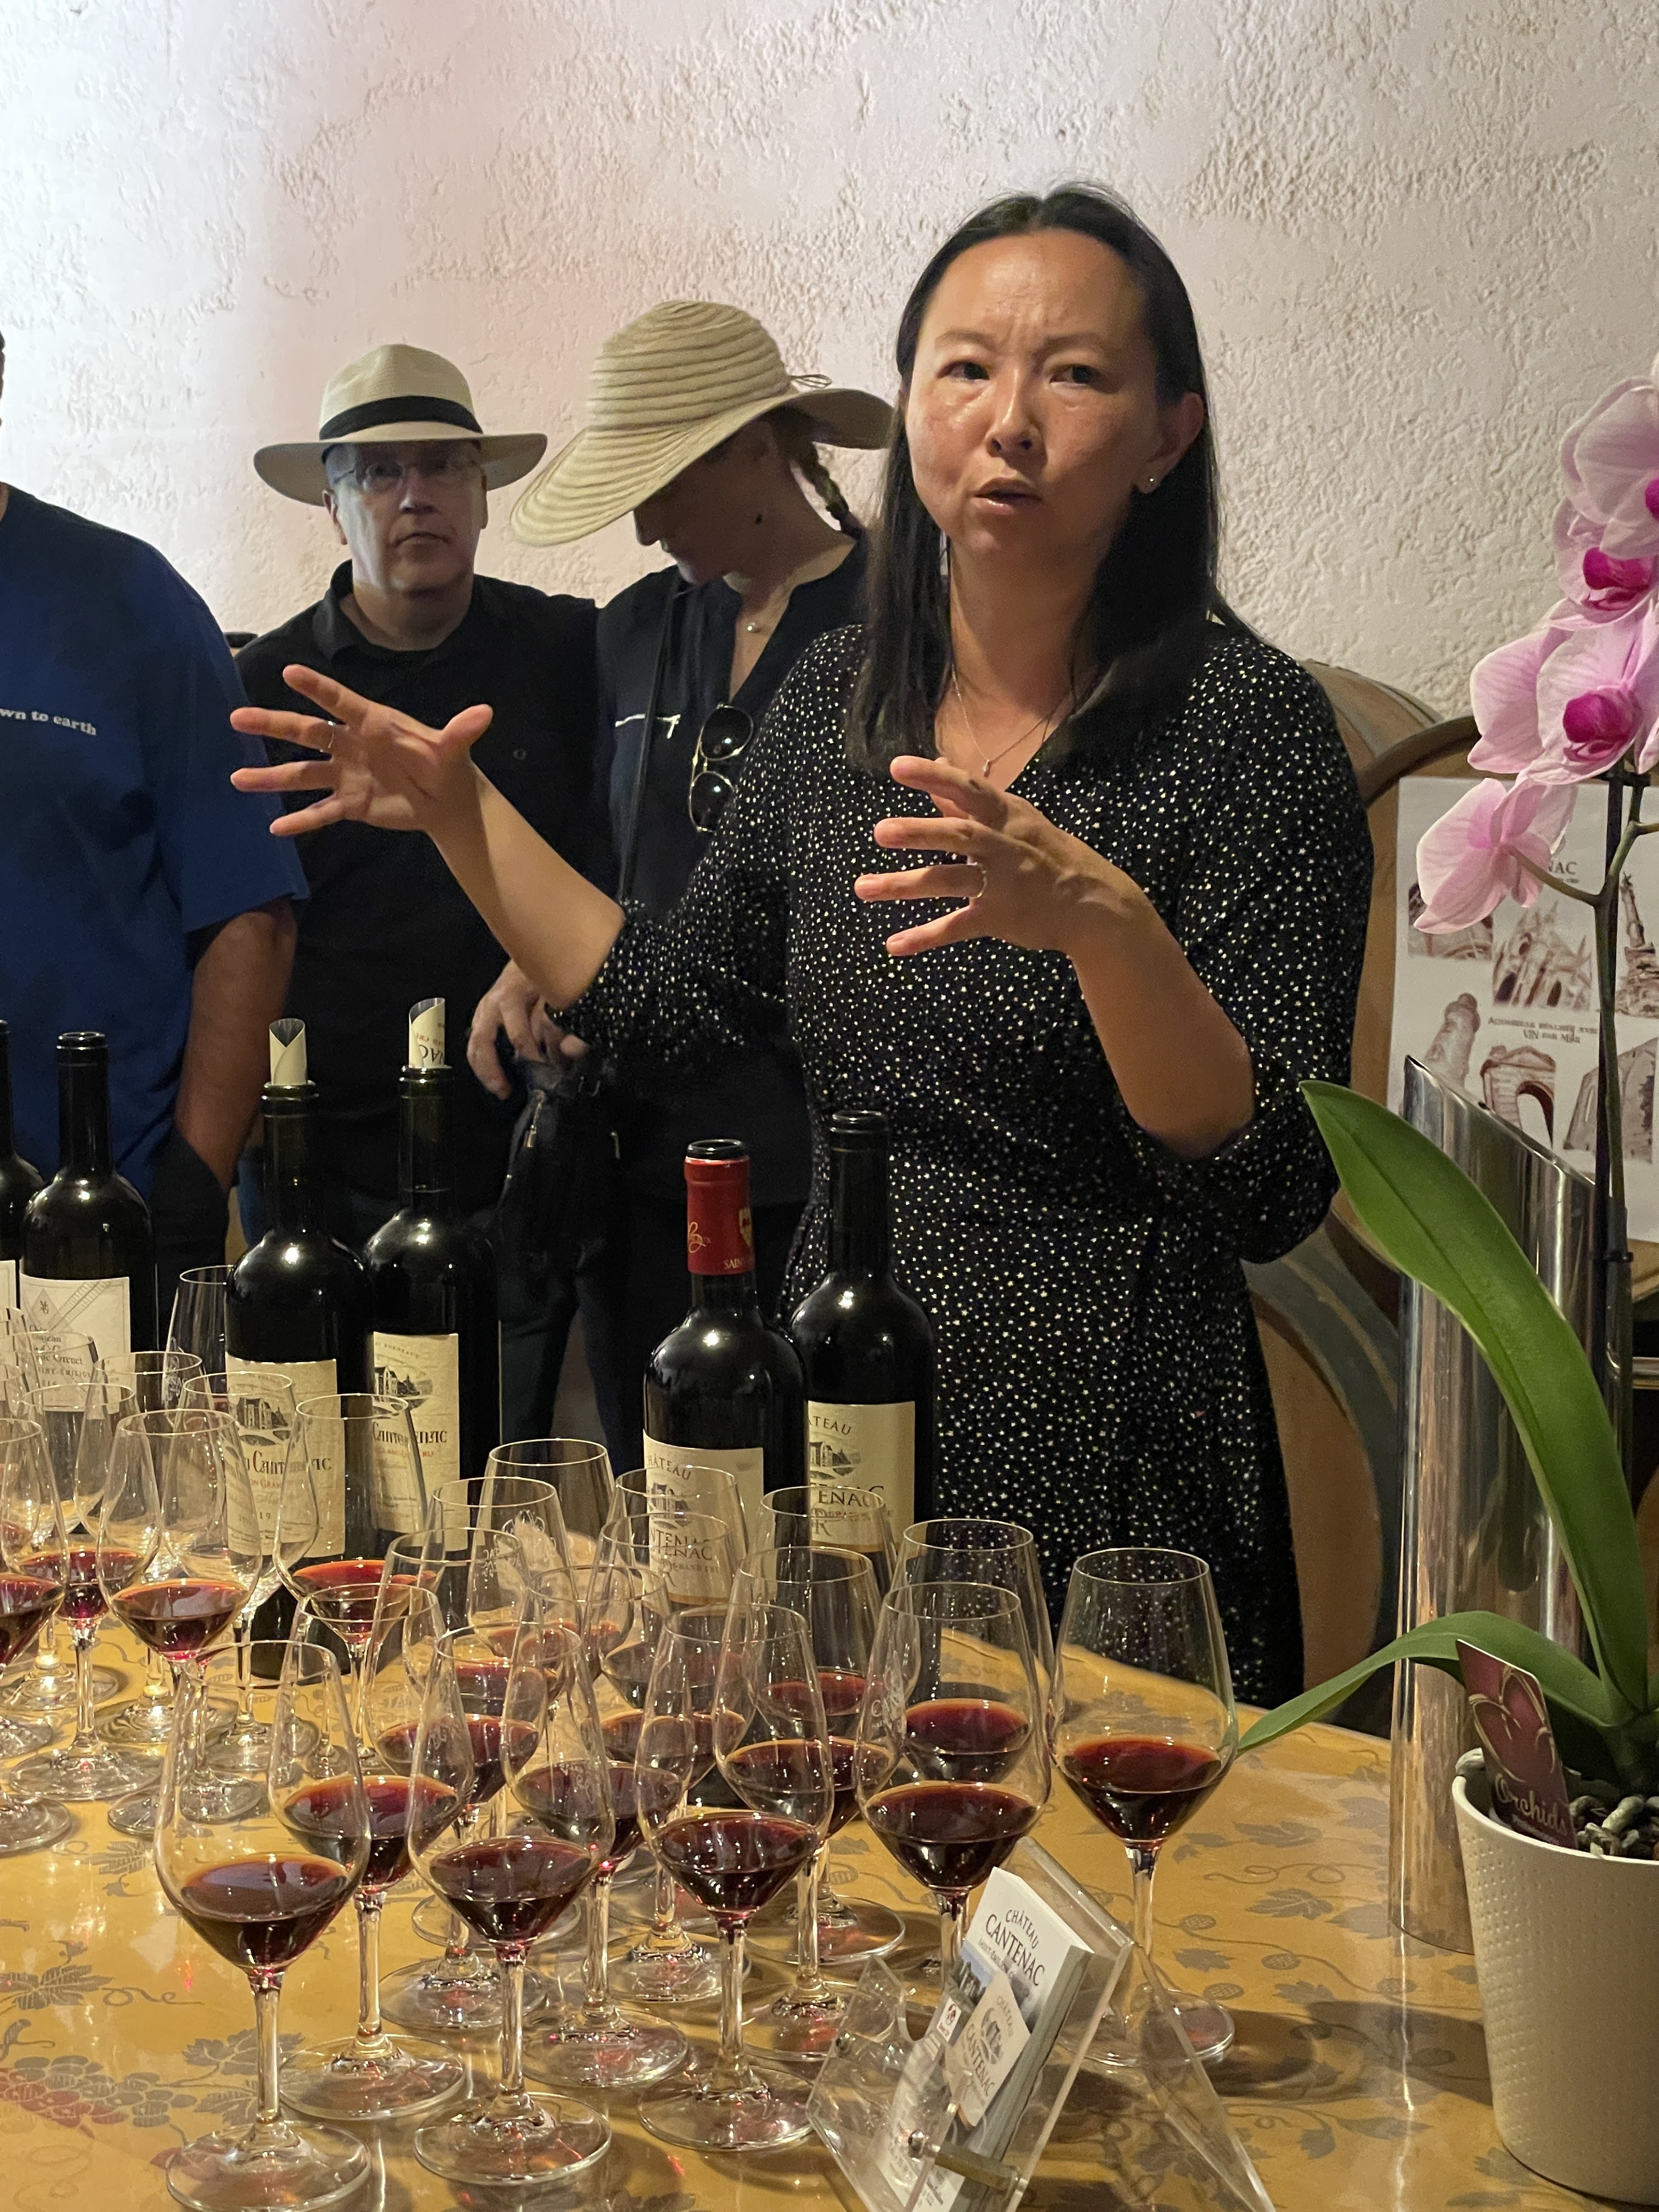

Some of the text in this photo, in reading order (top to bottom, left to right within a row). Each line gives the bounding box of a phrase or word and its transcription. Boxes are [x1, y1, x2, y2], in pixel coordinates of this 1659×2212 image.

[31, 711, 49, 722] to
[53, 715, 97, 736] earth
[985, 1914, 1045, 1987] CANTENAC
[1006, 1909, 1039, 1949] CHÂTEAU
[966, 2023, 995, 2096] CANTENAC
